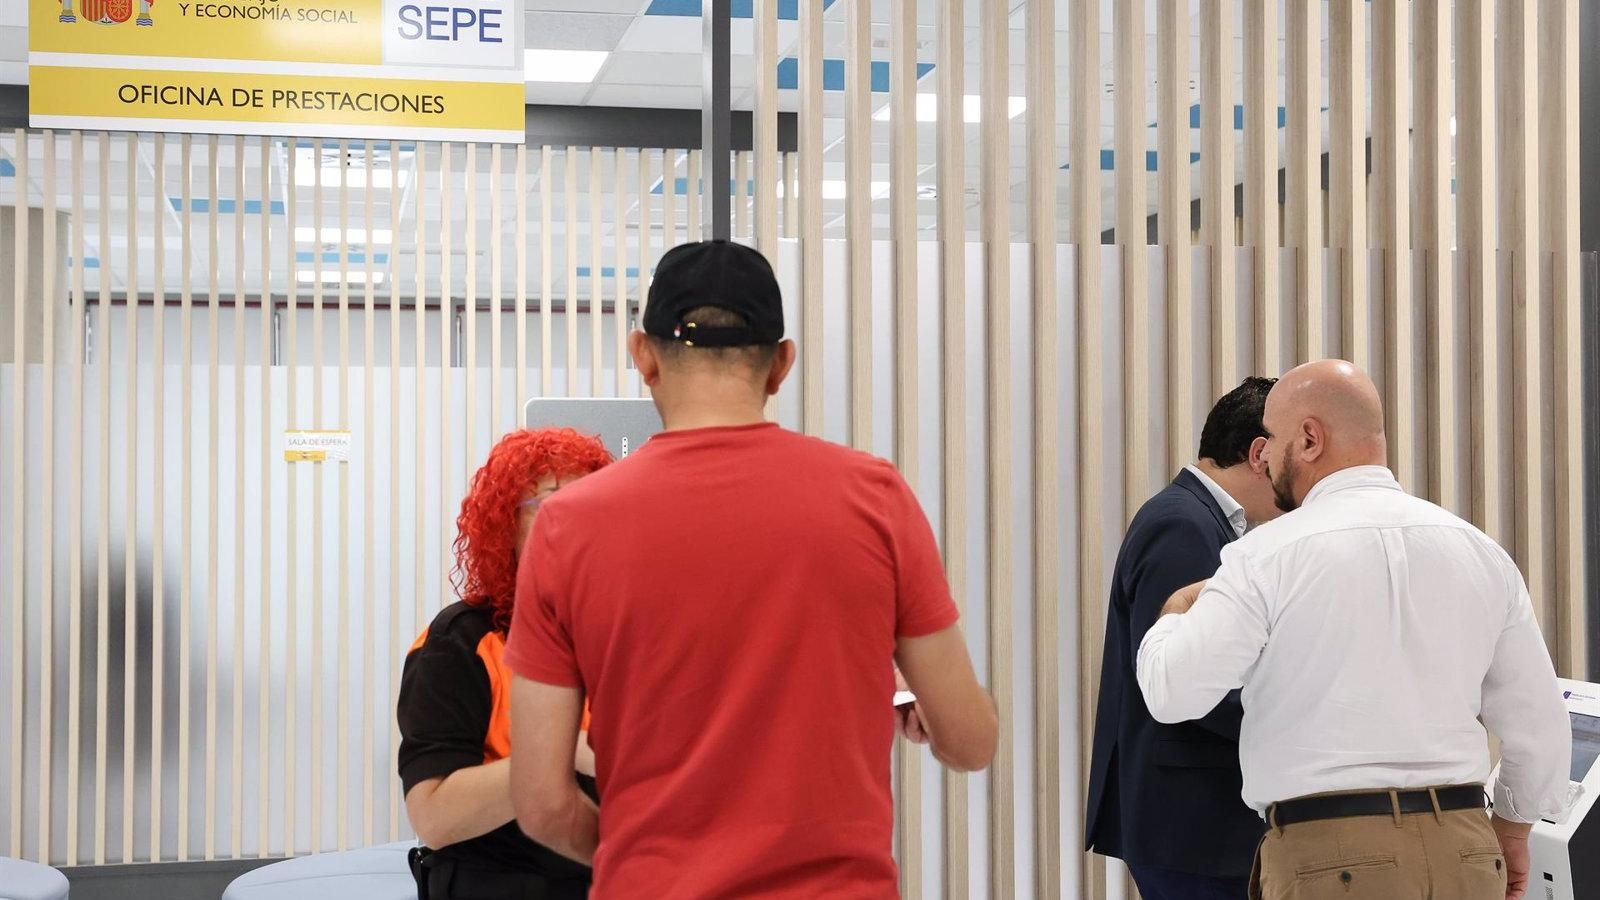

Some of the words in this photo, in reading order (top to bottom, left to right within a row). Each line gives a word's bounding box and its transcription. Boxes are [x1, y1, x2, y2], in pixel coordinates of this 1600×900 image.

[179, 4, 189, 17] Y
[195, 4, 292, 21] ECONOMÍA
[297, 9, 358, 24] SOCIAL
[397, 4, 504, 43] SEPE
[118, 84, 223, 106] OFICINA
[232, 88, 264, 108] DE
[272, 90, 445, 114] PRESTACIONES
[288, 438, 307, 446] SALA
